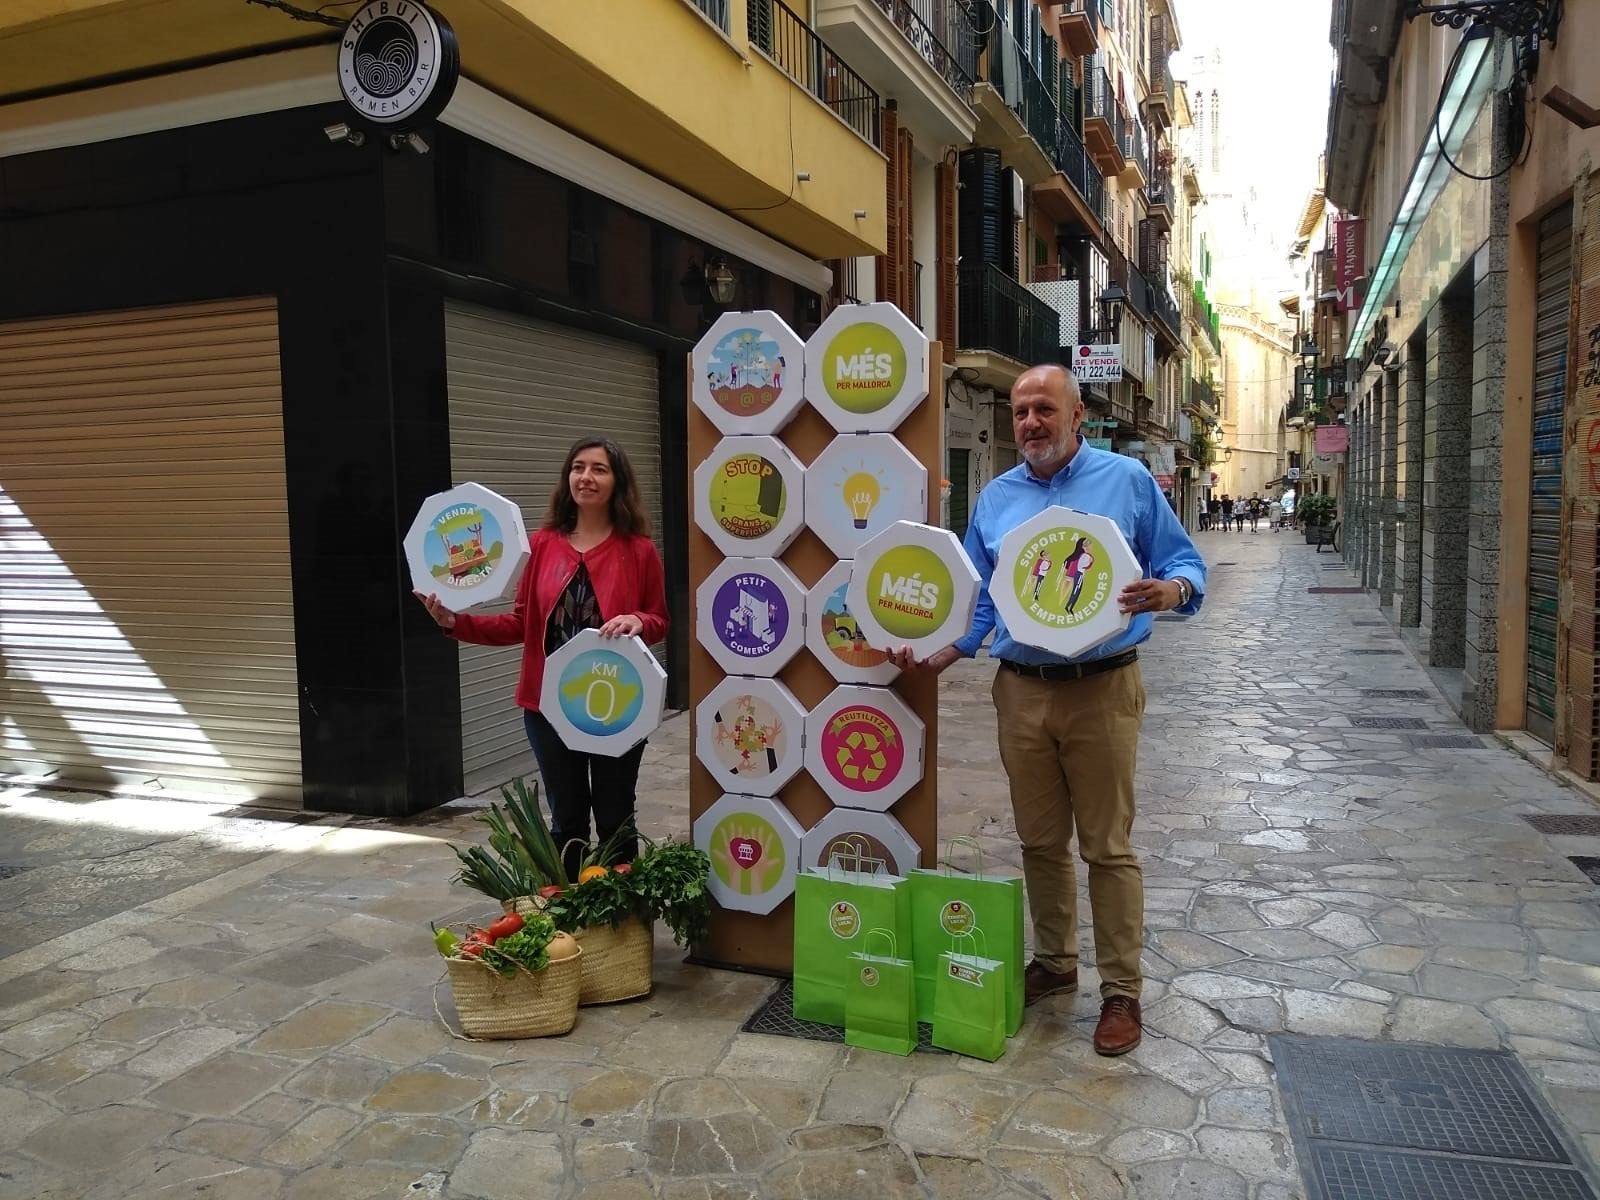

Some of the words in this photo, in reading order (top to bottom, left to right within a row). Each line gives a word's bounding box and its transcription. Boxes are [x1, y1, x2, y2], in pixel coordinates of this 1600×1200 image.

[344, 1, 418, 50] SHIBUI
[349, 87, 400, 112] RAMEN
[409, 63, 430, 97] BAR
[836, 348, 893, 380] MÉS
[1072, 366, 1086, 378] 971
[1089, 366, 1104, 378] 222
[1106, 365, 1121, 377] 444
[836, 381, 850, 390] PER
[852, 381, 892, 390] MALLORCA
[725, 459, 773, 479] STOP
[439, 507, 474, 524] VENDA
[1020, 531, 1066, 568] SUPORT
[447, 566, 493, 587] DIRECTA
[735, 576, 766, 588] PETIT
[880, 572, 939, 607] MÉS
[1029, 571, 1108, 625] EMPRENEDORS
[878, 598, 893, 609] PER
[894, 602, 934, 620] MALLORCA
[730, 641, 770, 653] COMERÇ
[591, 662, 618, 678] KM
[586, 680, 615, 721] 0
[839, 712, 889, 731] REUTILITZA
